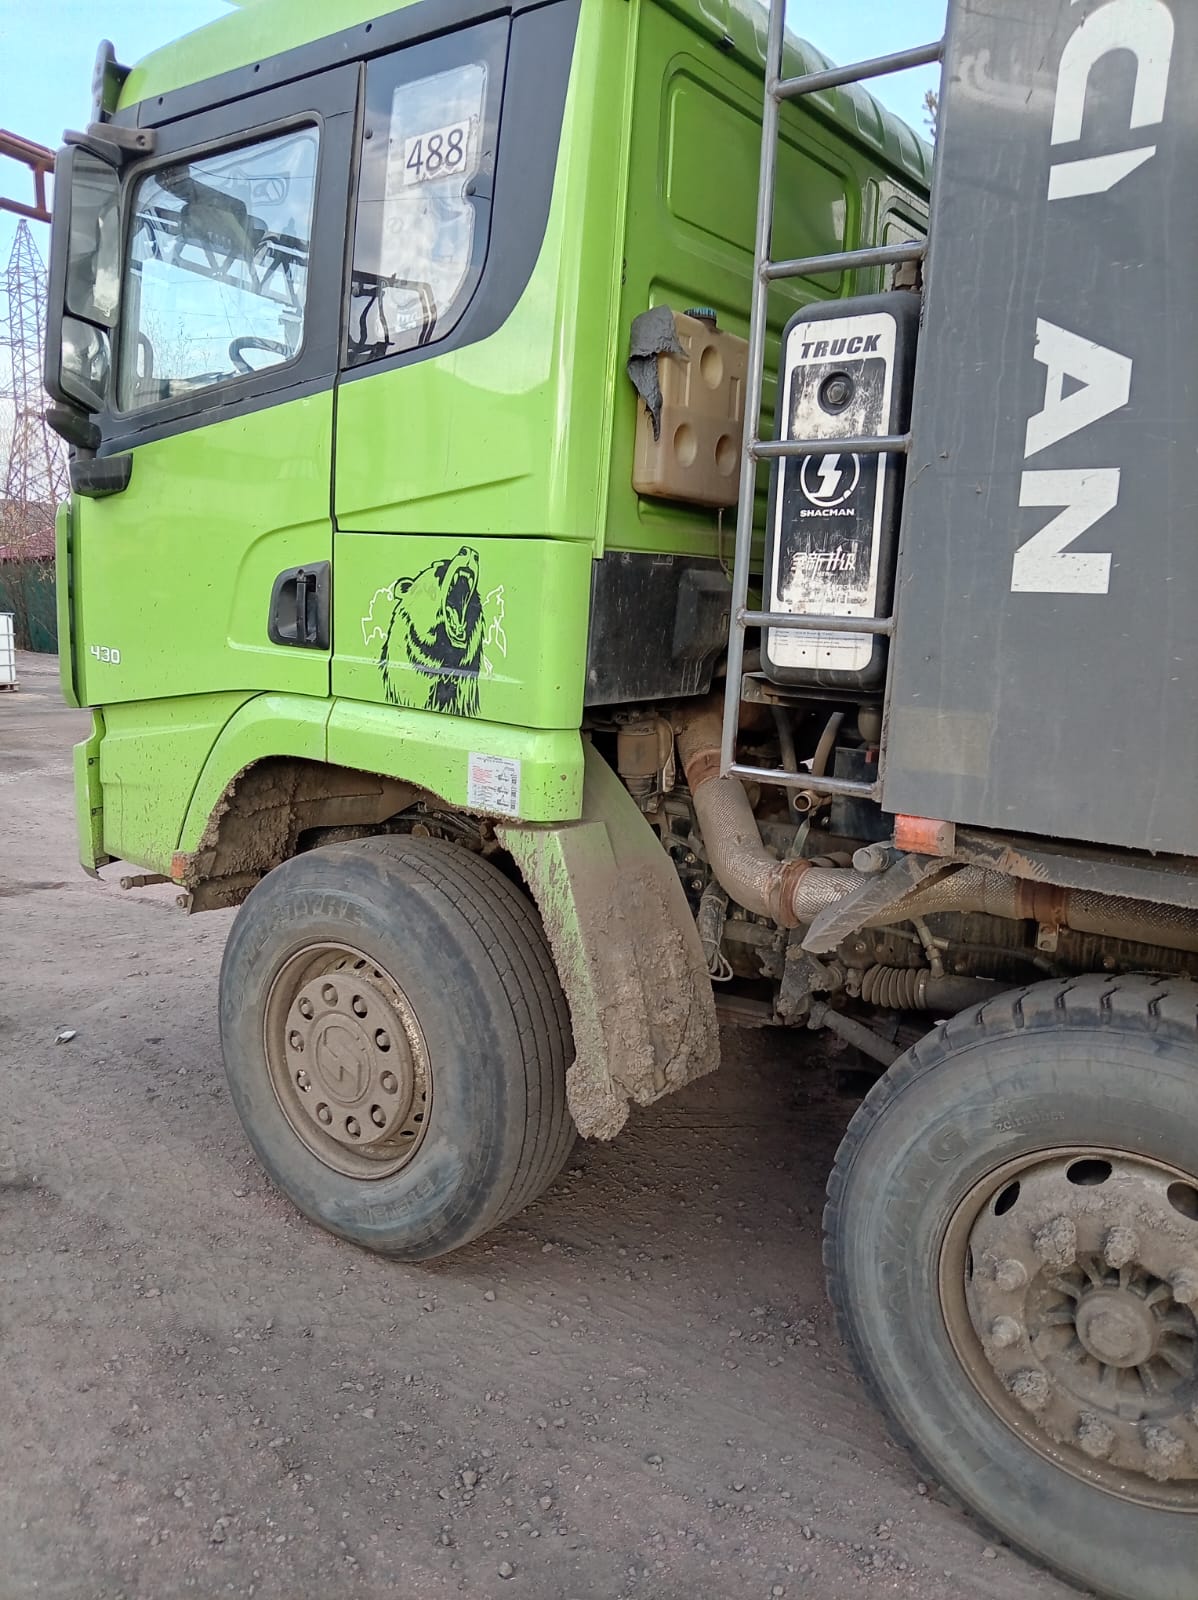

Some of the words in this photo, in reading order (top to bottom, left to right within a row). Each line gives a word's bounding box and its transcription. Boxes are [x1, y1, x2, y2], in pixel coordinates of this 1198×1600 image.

[407, 128, 464, 176] 488
[801, 334, 881, 359] TRUCK
[800, 508, 855, 518] SHACMAN
[90, 645, 120, 664] 430
